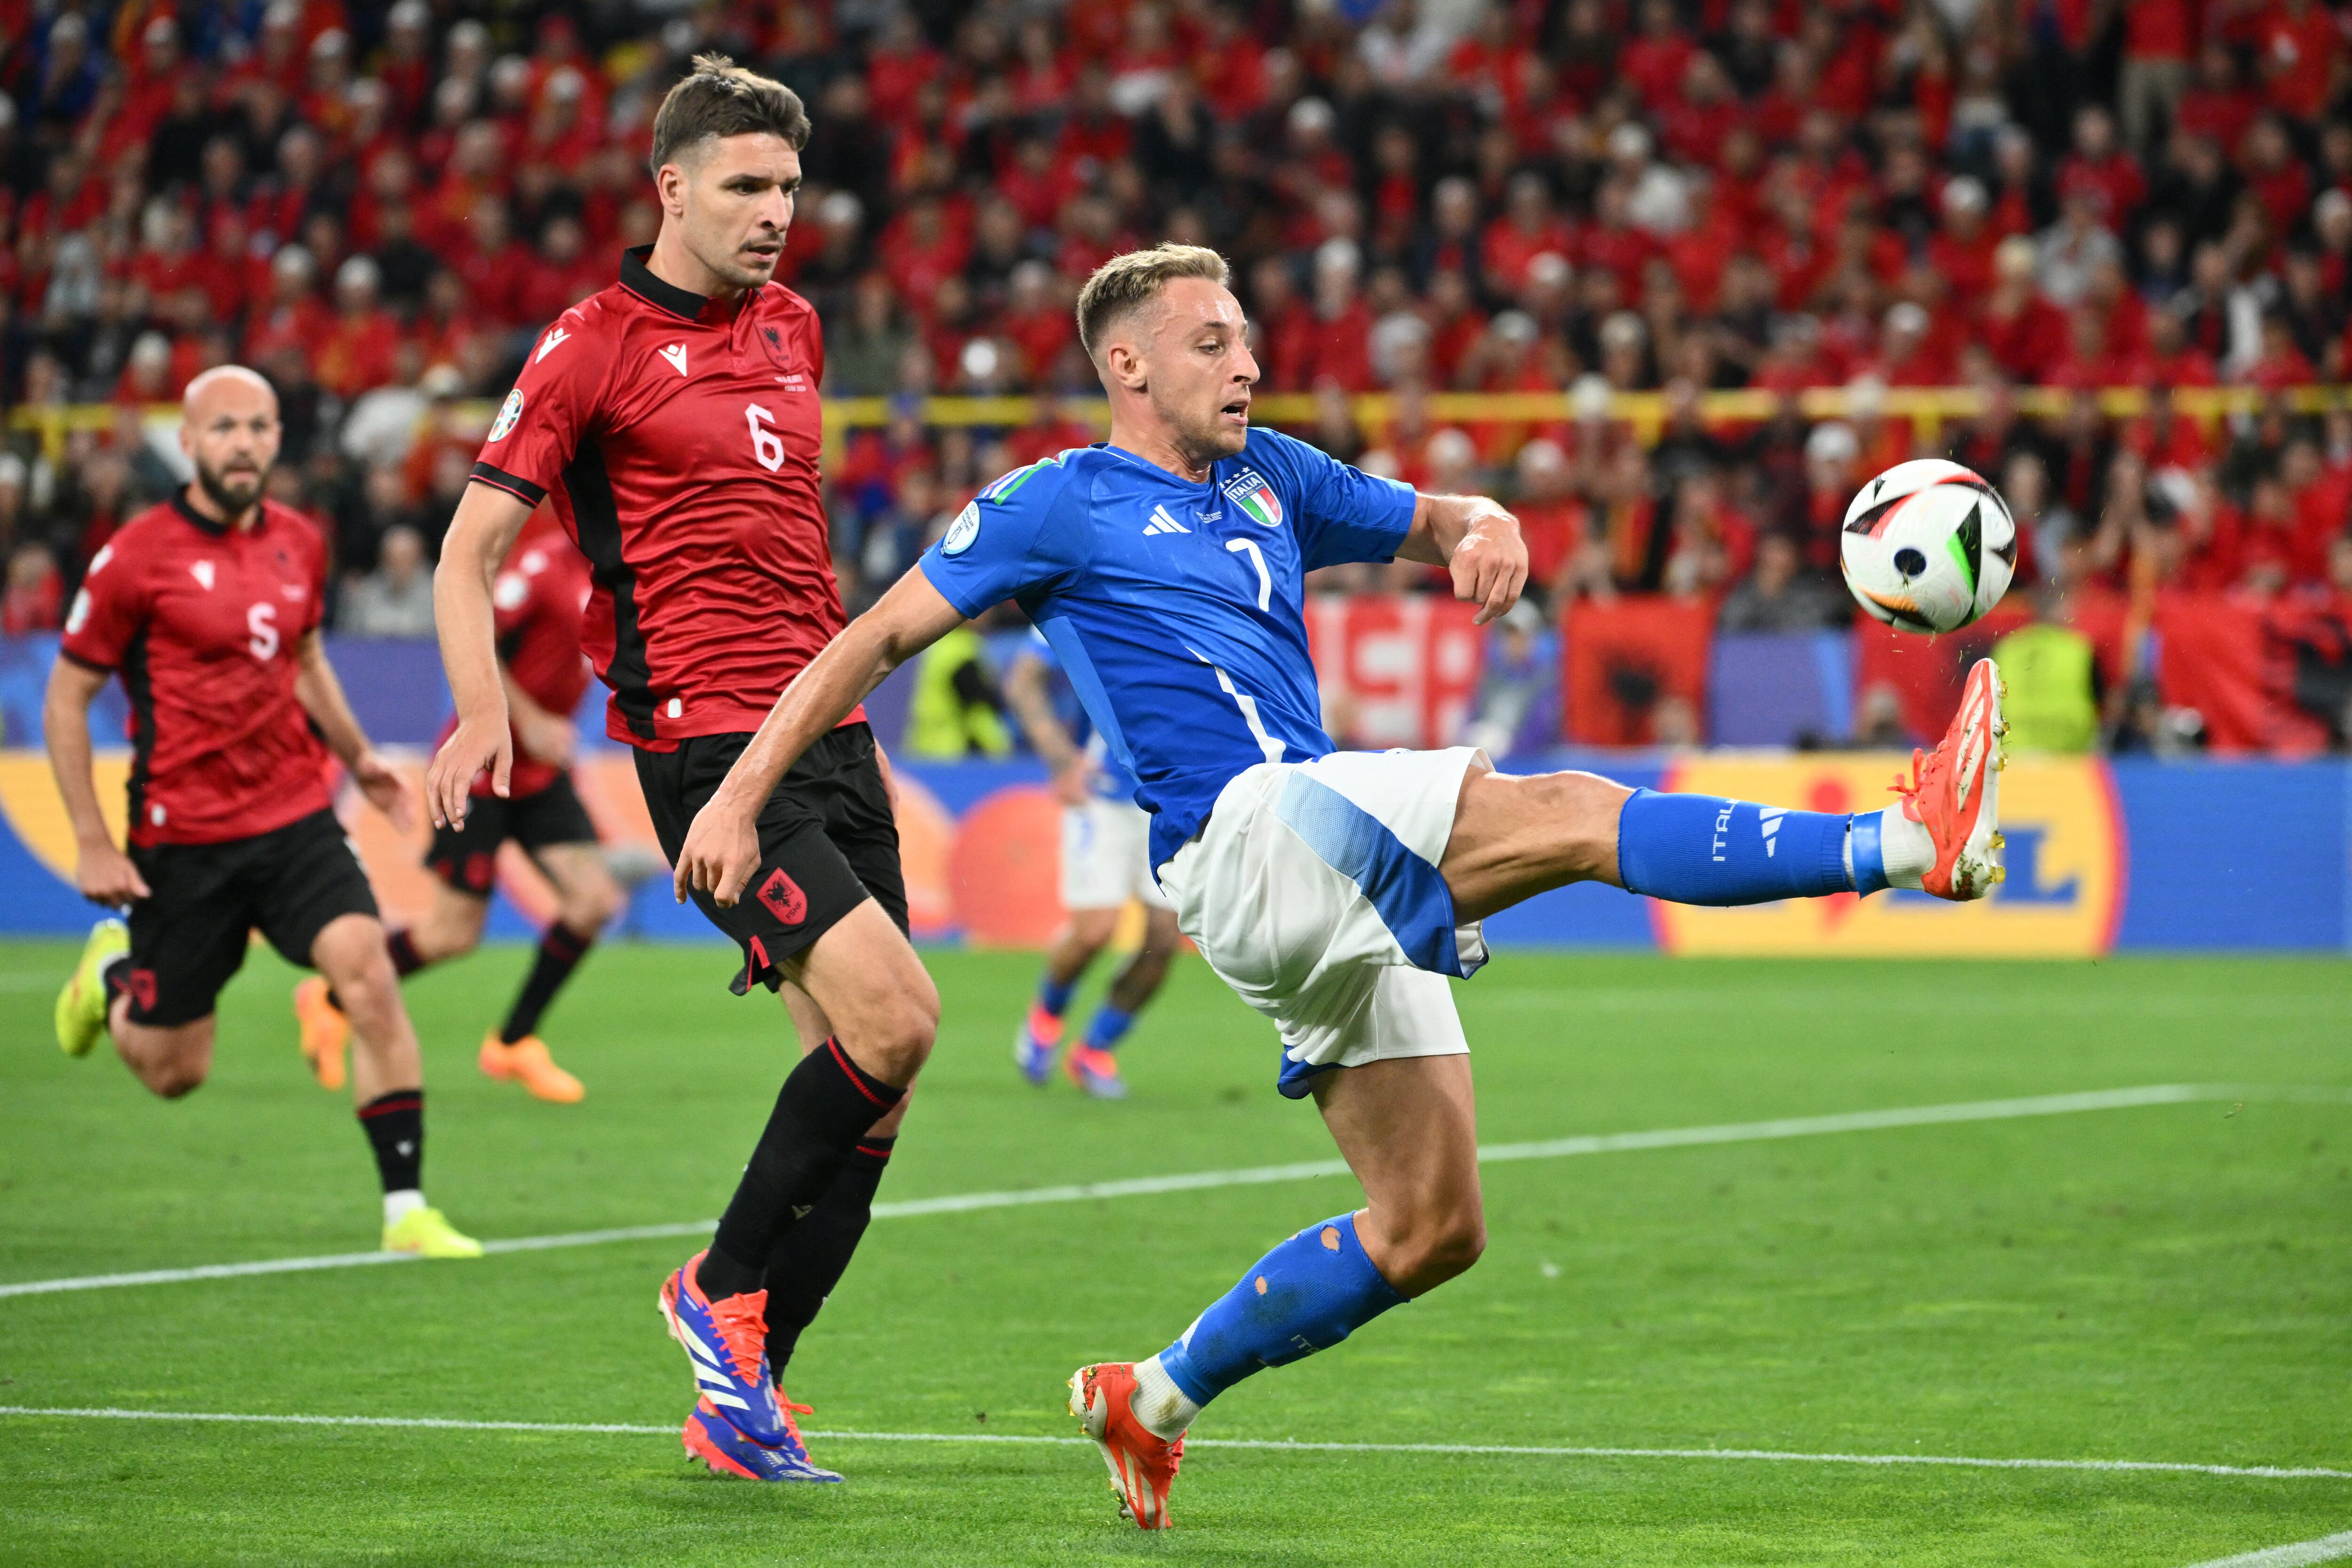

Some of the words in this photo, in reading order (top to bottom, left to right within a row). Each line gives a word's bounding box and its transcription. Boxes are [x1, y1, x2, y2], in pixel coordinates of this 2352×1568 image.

[745, 403, 785, 473] 6
[1228, 477, 1262, 499] ITALIA
[1225, 538, 1271, 612] 7
[786, 901, 802, 920] FSHF
